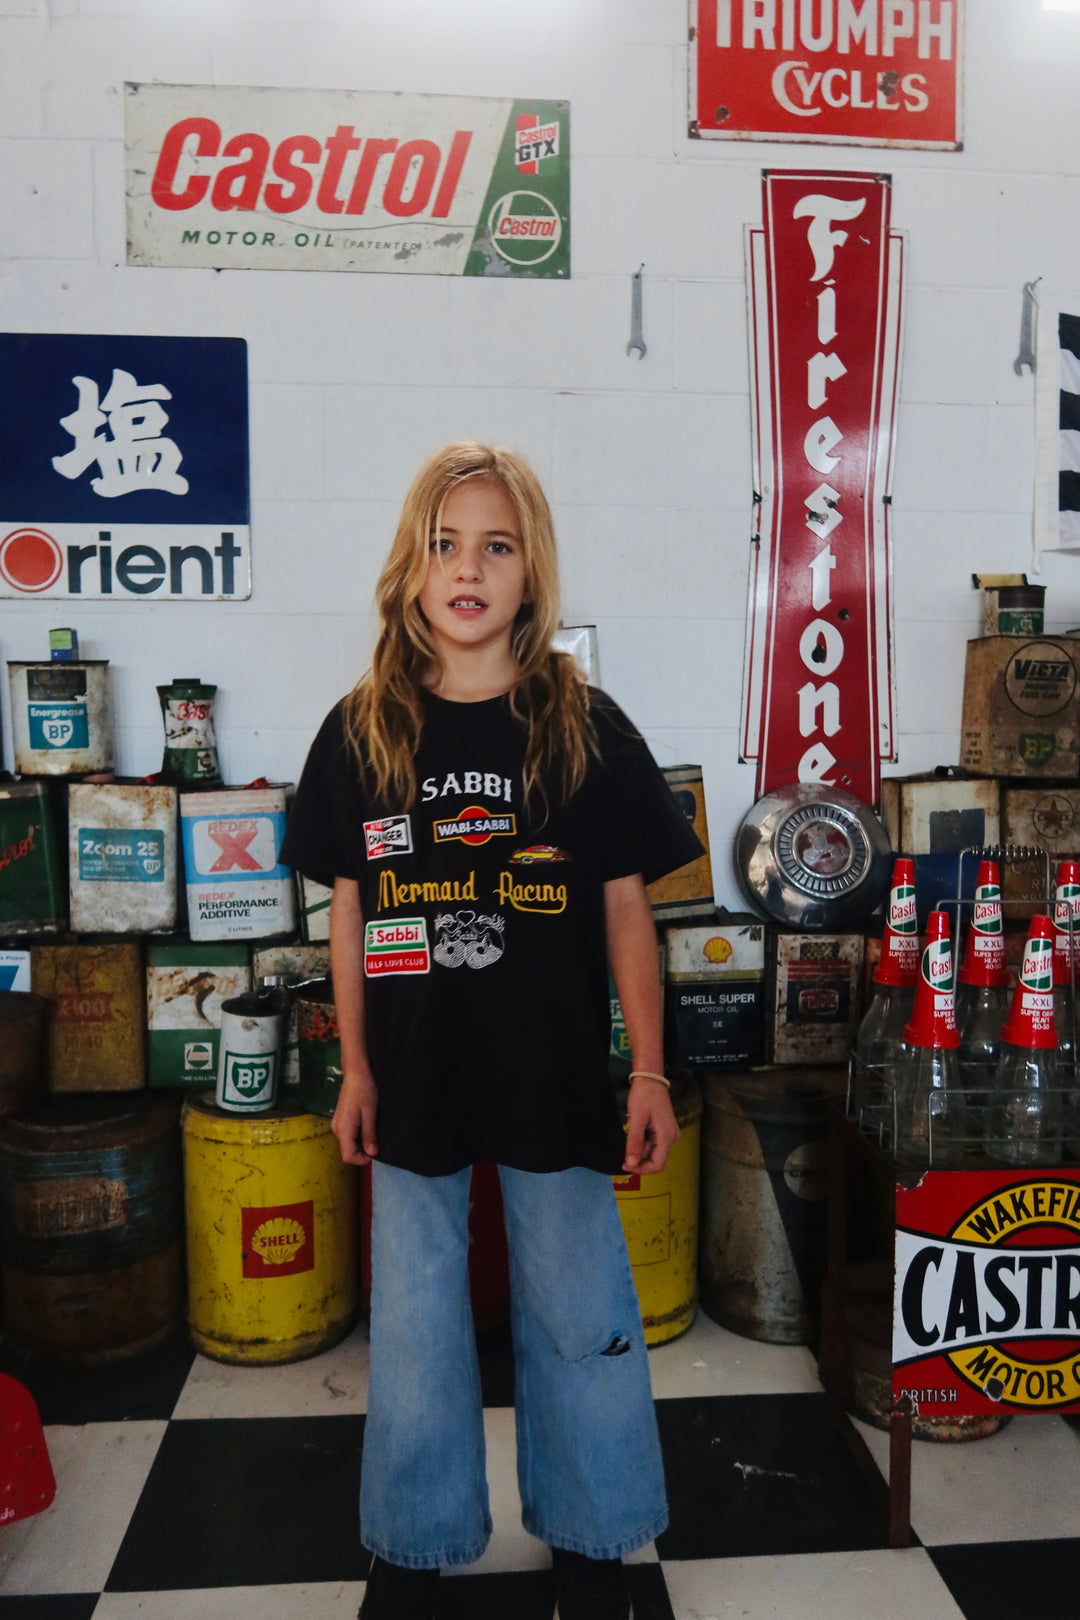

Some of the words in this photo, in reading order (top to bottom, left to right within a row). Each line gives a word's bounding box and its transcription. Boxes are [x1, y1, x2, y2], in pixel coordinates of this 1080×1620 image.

[771, 60, 929, 117] CYCLES
[519, 123, 557, 144] Castrol
[518, 138, 555, 162] GTX
[150, 117, 474, 218] Castrol
[499, 217, 557, 236] Castrol
[182, 230, 274, 246] MOTOR
[294, 232, 335, 248] OIL
[51, 368, 190, 498] 塩
[793, 194, 867, 787] Firestone
[48, 724, 71, 739] BP
[421, 771, 512, 802] SABBI
[207, 820, 259, 834] REDEX
[438, 817, 510, 836] WABI-SABBI
[137, 841, 159, 857] 25
[377, 869, 480, 913] Mermaid
[492, 870, 568, 914] Racing
[198, 897, 279, 911] PERFORMANCE
[199, 908, 252, 920] ADDITIVE
[376, 926, 419, 944] Sabbi
[680, 994, 716, 1006] SHELL
[719, 992, 756, 1005] SUPER
[697, 1006, 724, 1014] MOTOR
[726, 1006, 739, 1014] OIL
[236, 1067, 267, 1088] BP
[259, 1232, 299, 1248] SHELL
[965, 1347, 1067, 1400] MOTOR
